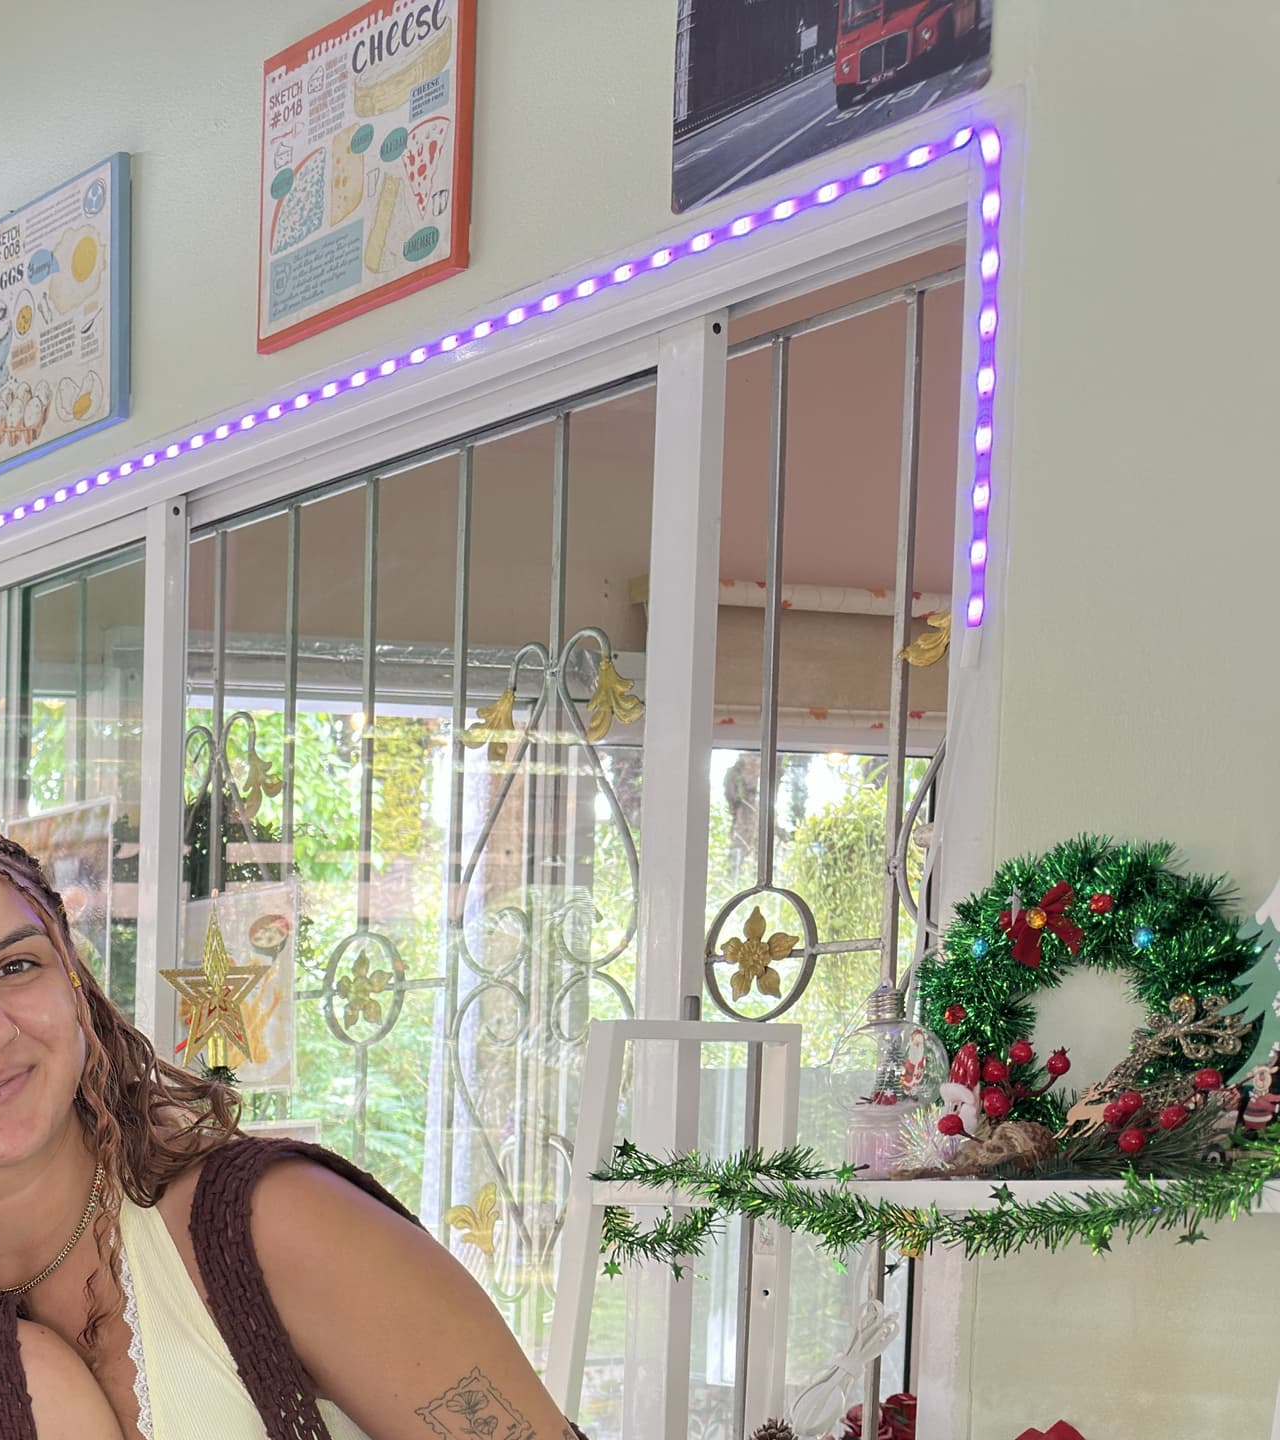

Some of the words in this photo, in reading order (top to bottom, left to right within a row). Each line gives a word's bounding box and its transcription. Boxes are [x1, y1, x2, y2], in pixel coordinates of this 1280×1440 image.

[269, 79, 303, 110] SKETCH
[411, 78, 440, 98] CHEESE
[269, 103, 303, 130] #018
